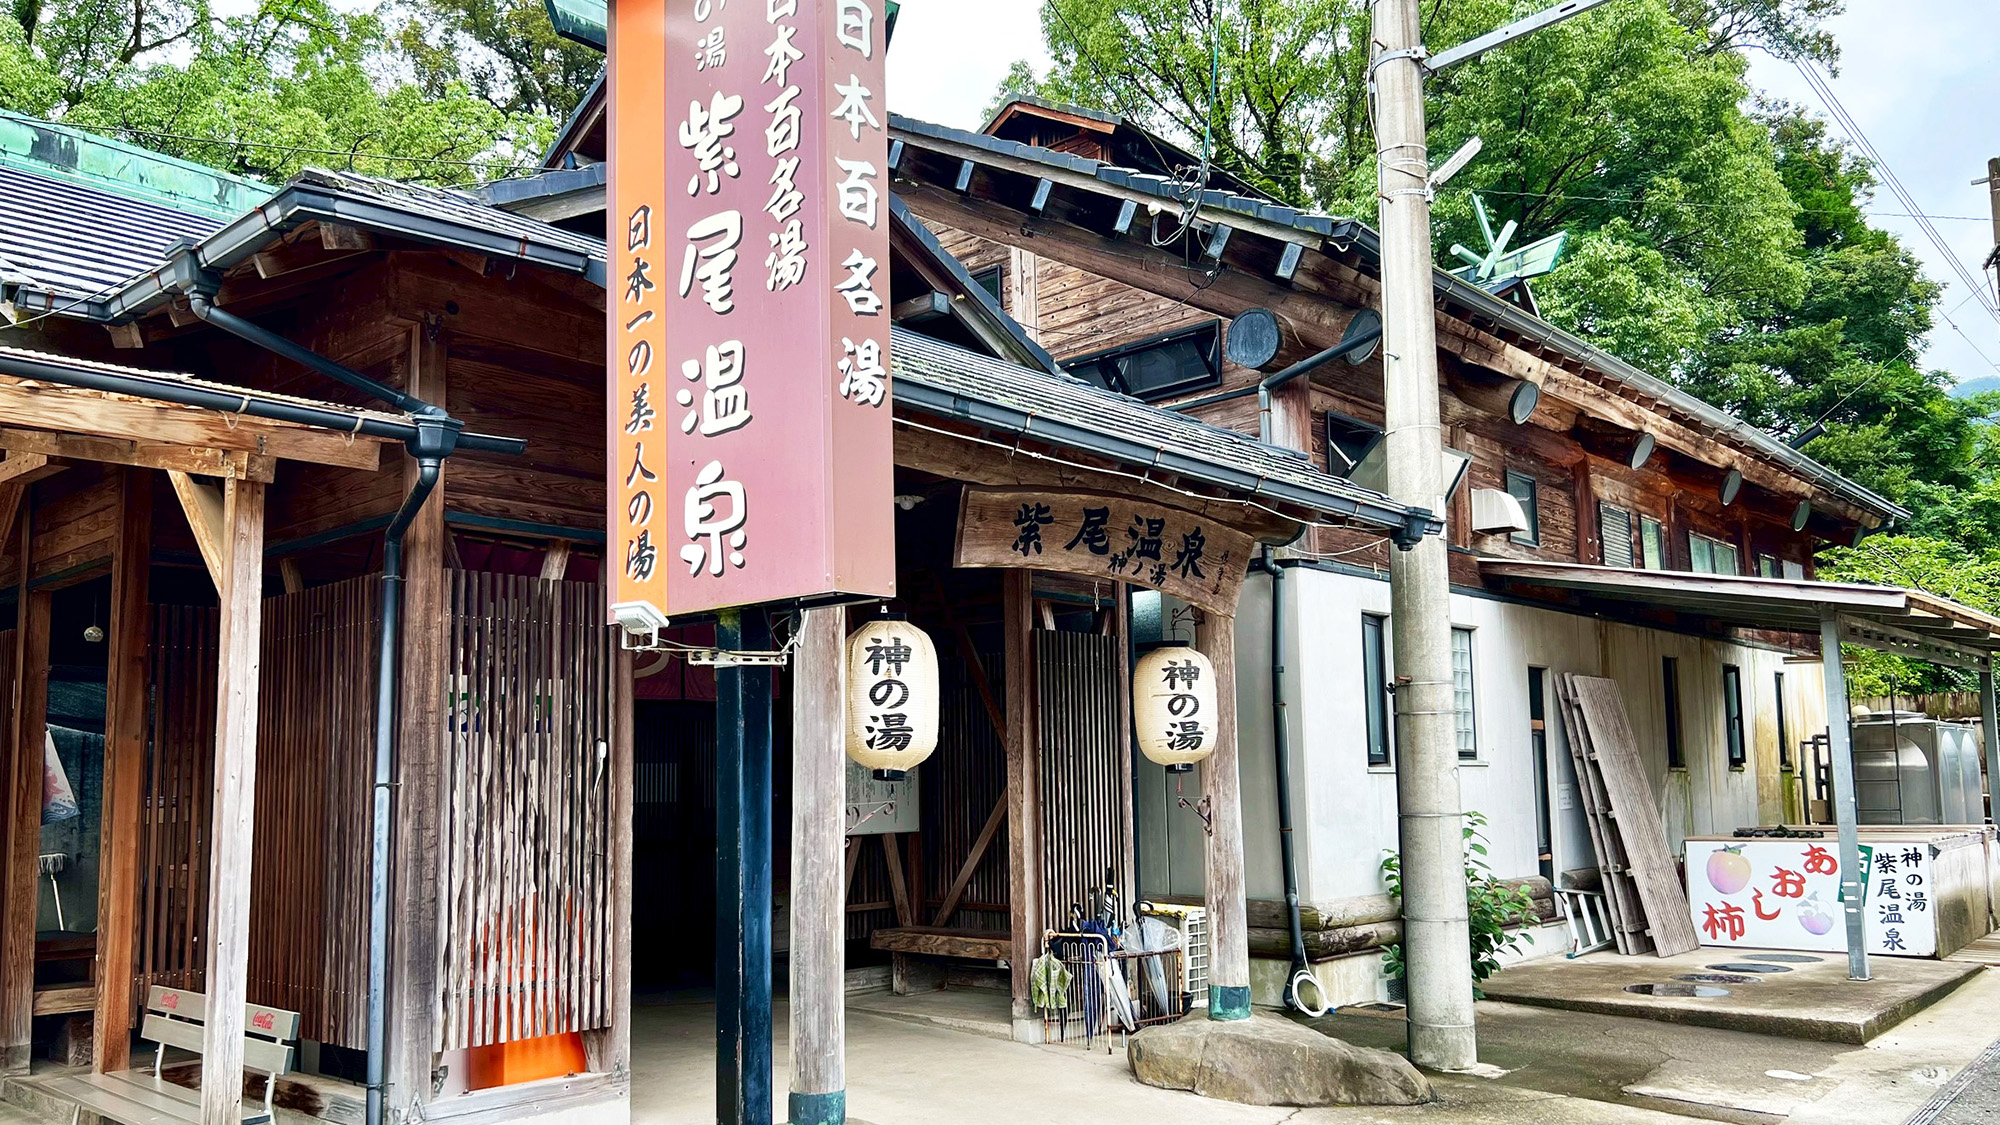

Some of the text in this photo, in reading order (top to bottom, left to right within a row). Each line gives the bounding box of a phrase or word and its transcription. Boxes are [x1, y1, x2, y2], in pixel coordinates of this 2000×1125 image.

[832, 0, 888, 409] 日本百名湯
[676, 90, 753, 577] 紫尾温泉
[625, 204, 658, 583] 日本一の美人の湯
[1011, 501, 1206, 580] 紫尾温泉
[864, 636, 914, 752] 神の湯
[1161, 659, 1205, 752] 神の湯
[1874, 852, 1907, 951] 紫尾温泉
[1901, 846, 1928, 912] 神の湯
